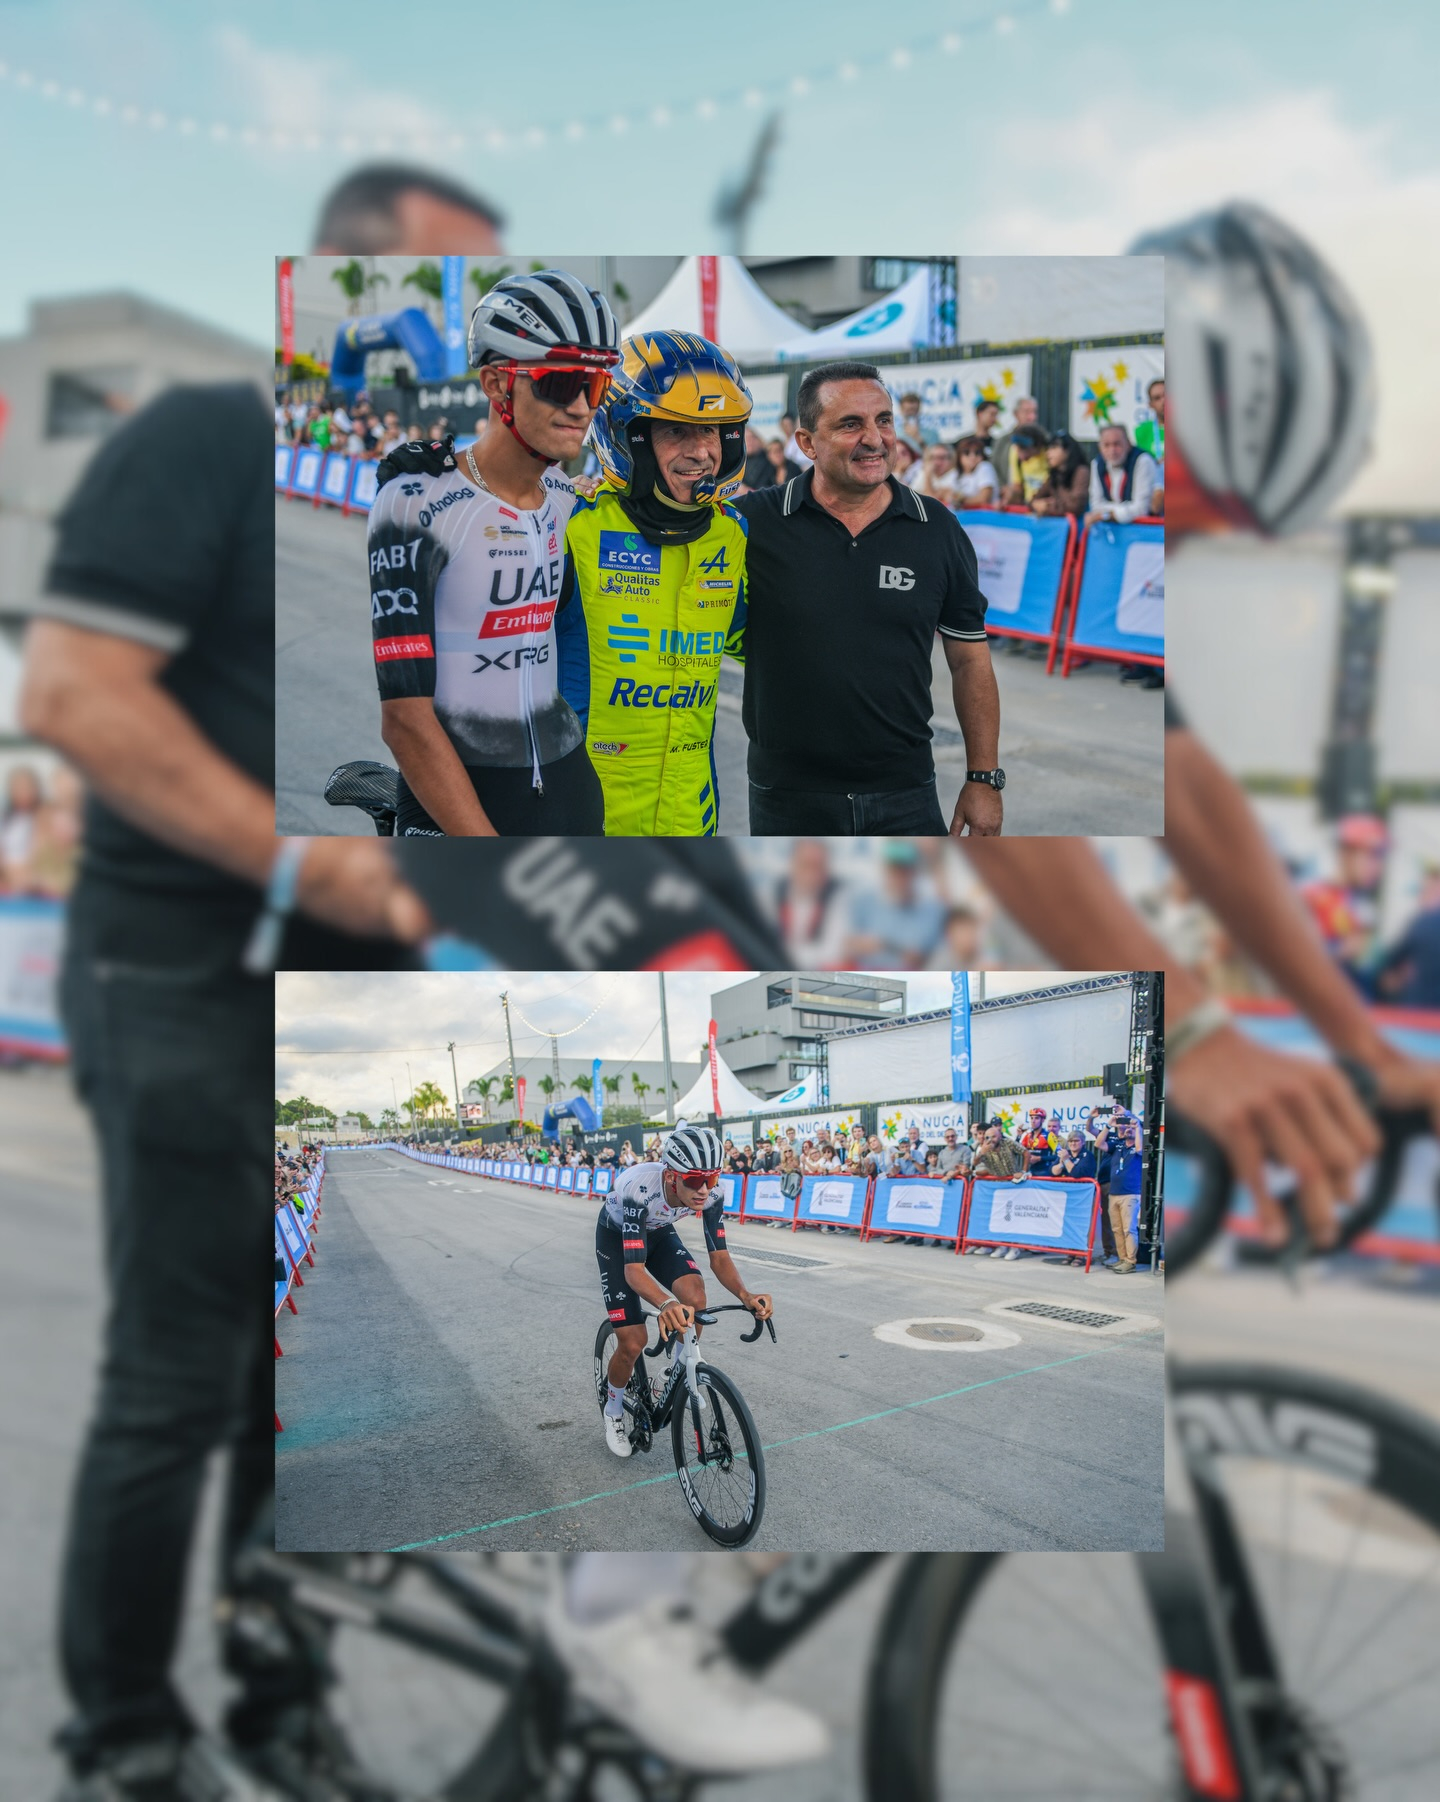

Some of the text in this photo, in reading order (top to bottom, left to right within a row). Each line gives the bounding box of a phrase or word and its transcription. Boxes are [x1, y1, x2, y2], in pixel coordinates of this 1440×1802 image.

[504, 298, 548, 331] MET
[431, 487, 475, 518] Analog
[498, 549, 528, 557] PISSEI
[608, 551, 652, 565] ECYC
[489, 560, 559, 606] UAE
[615, 572, 660, 586] Qualitas
[879, 565, 916, 591] DG
[623, 595, 660, 605] CLASSIC
[625, 584, 651, 596] Auto
[492, 609, 554, 630] Emirates
[375, 641, 429, 656] Emirates
[659, 629, 725, 655] IMED
[471, 643, 549, 674] XRG
[608, 677, 717, 708] Recalvi
[672, 1145, 688, 1163] MET
[1013, 1204, 1050, 1212] GENERALITAT
[1014, 1211, 1049, 1219] VALENCIANA
[600, 1271, 612, 1303] UAE
[659, 1363, 681, 1408] COLNAGO
